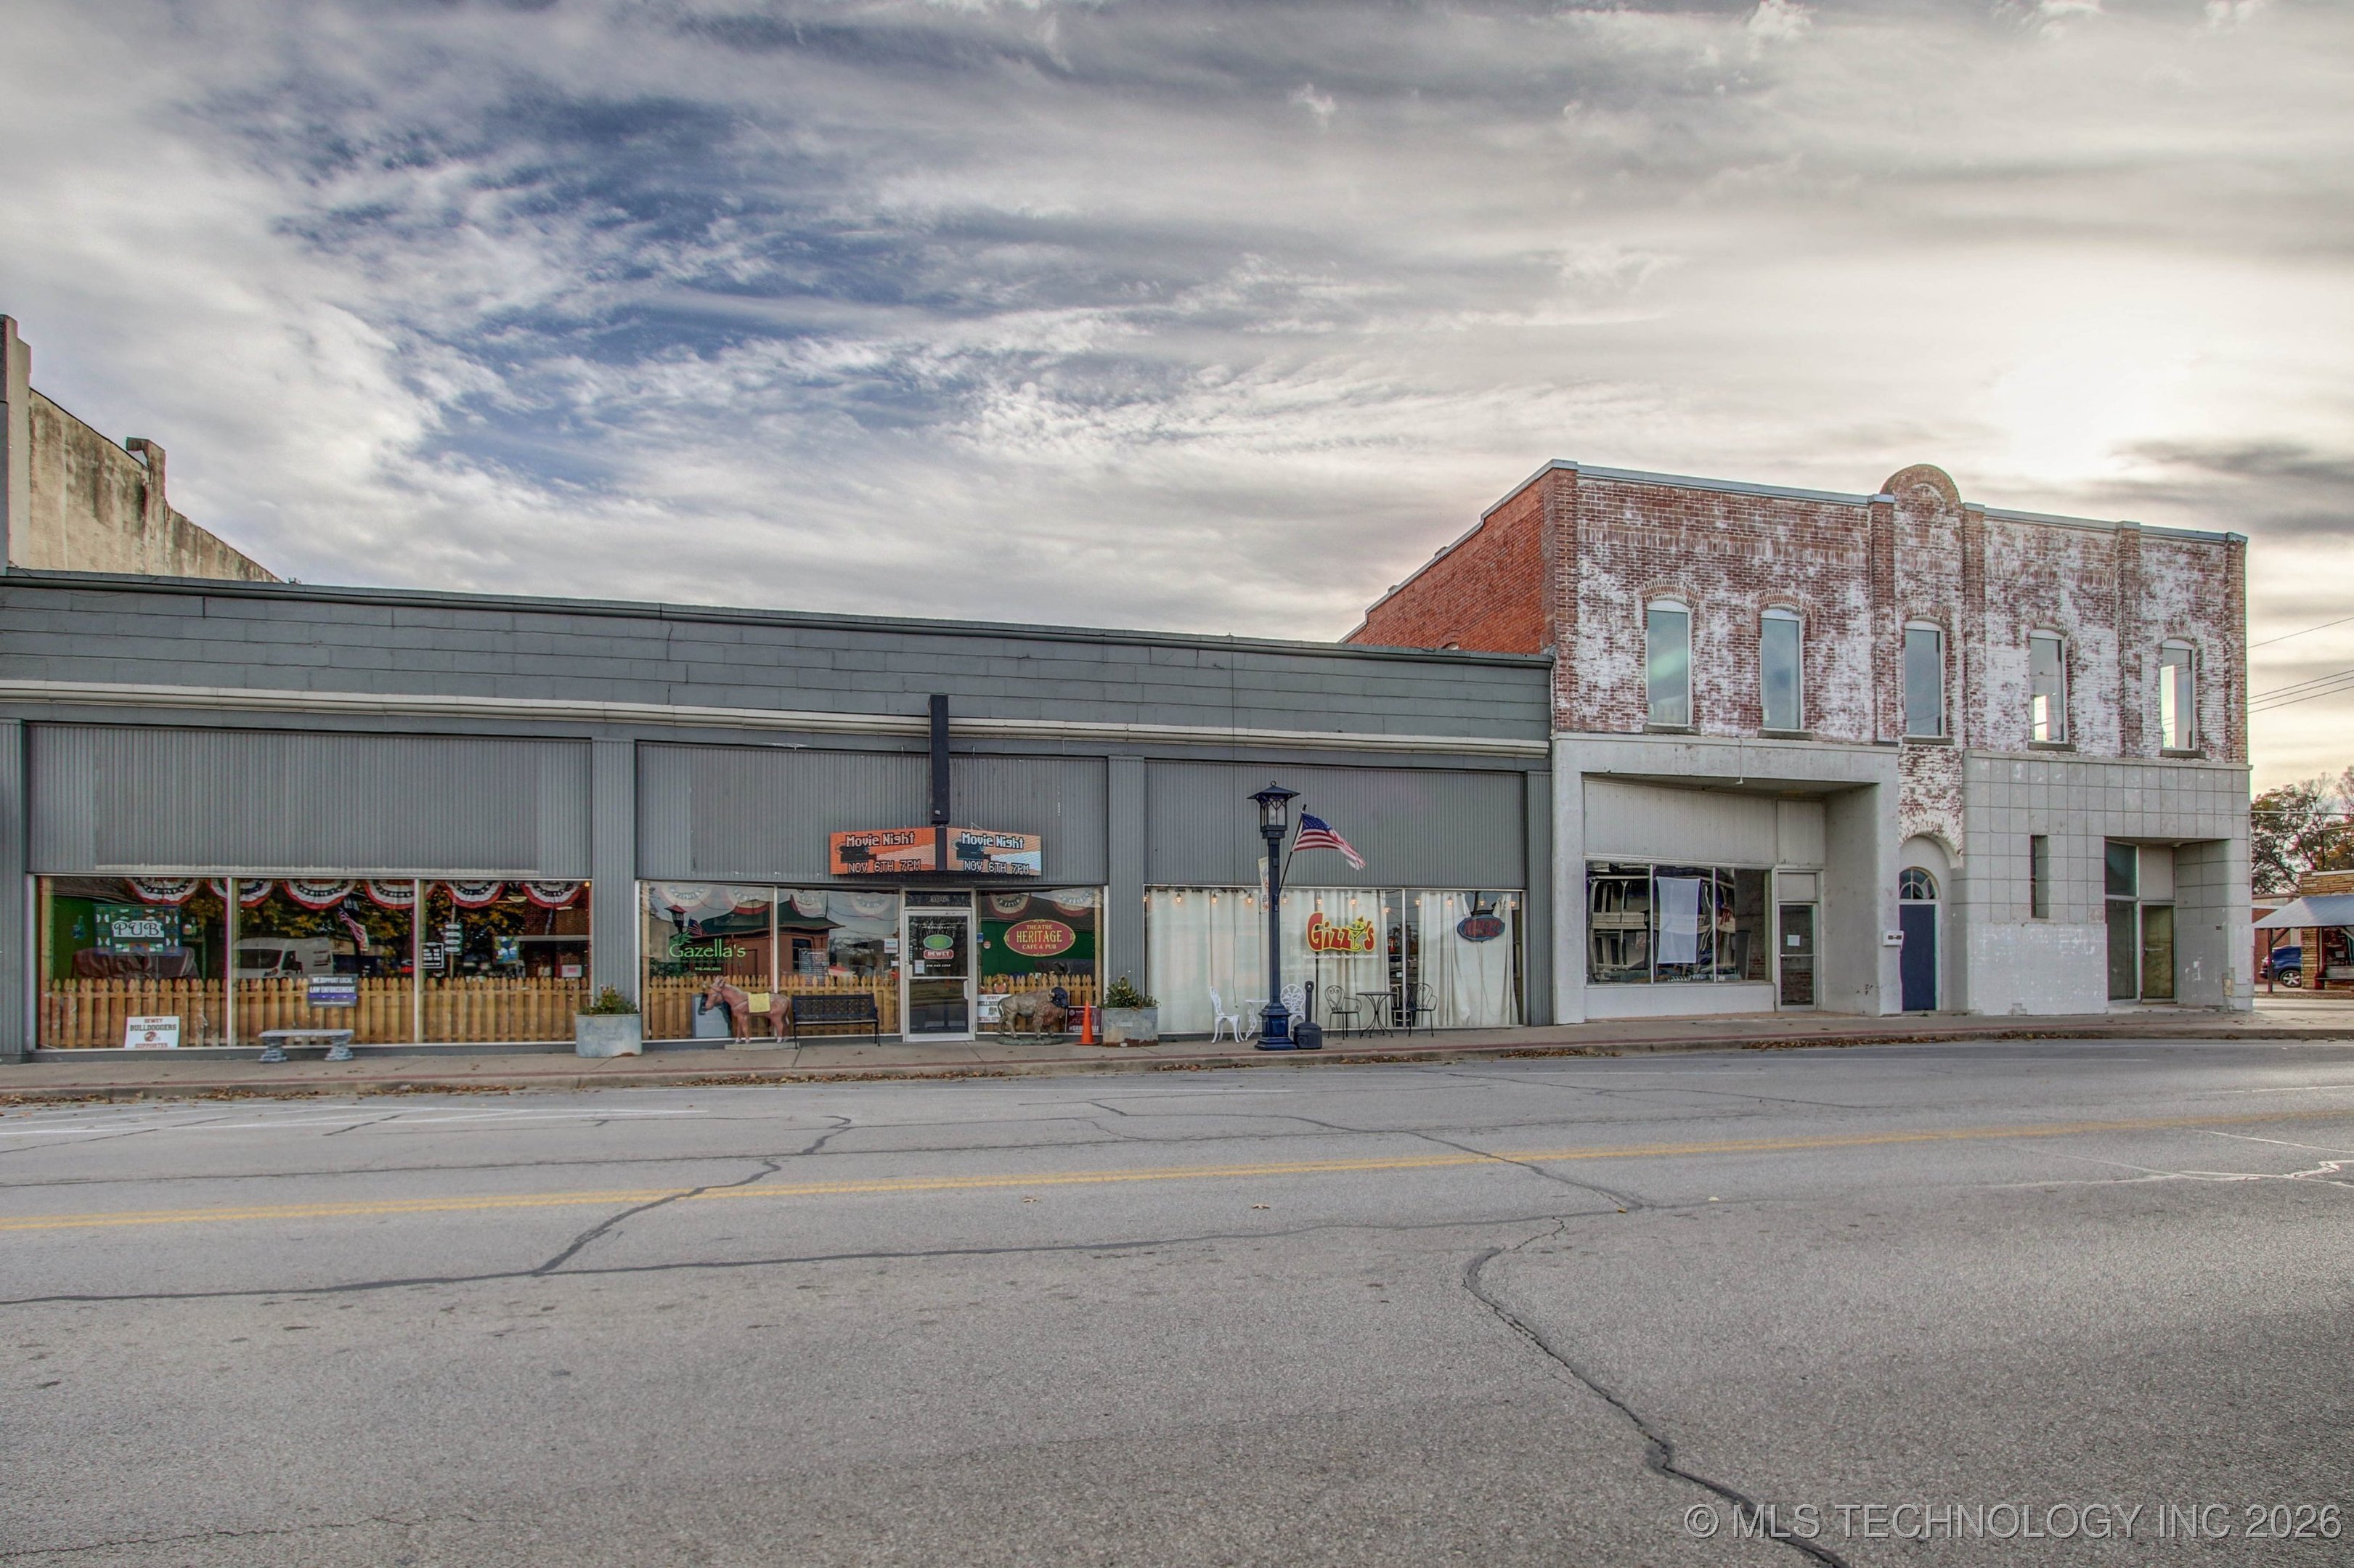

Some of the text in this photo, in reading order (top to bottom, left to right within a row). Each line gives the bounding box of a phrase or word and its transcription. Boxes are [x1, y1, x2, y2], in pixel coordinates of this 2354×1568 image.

[846, 831, 915, 847] Movie Night
[961, 832, 1024, 849] Movie Night
[848, 859, 921, 873] NOV 6TH 7PM
[964, 860, 1030, 875] NOV 6TH 7PM
[113, 922, 160, 936] PUB
[1017, 930, 1062, 943] HERITAGE
[669, 938, 746, 957] Gazella's
